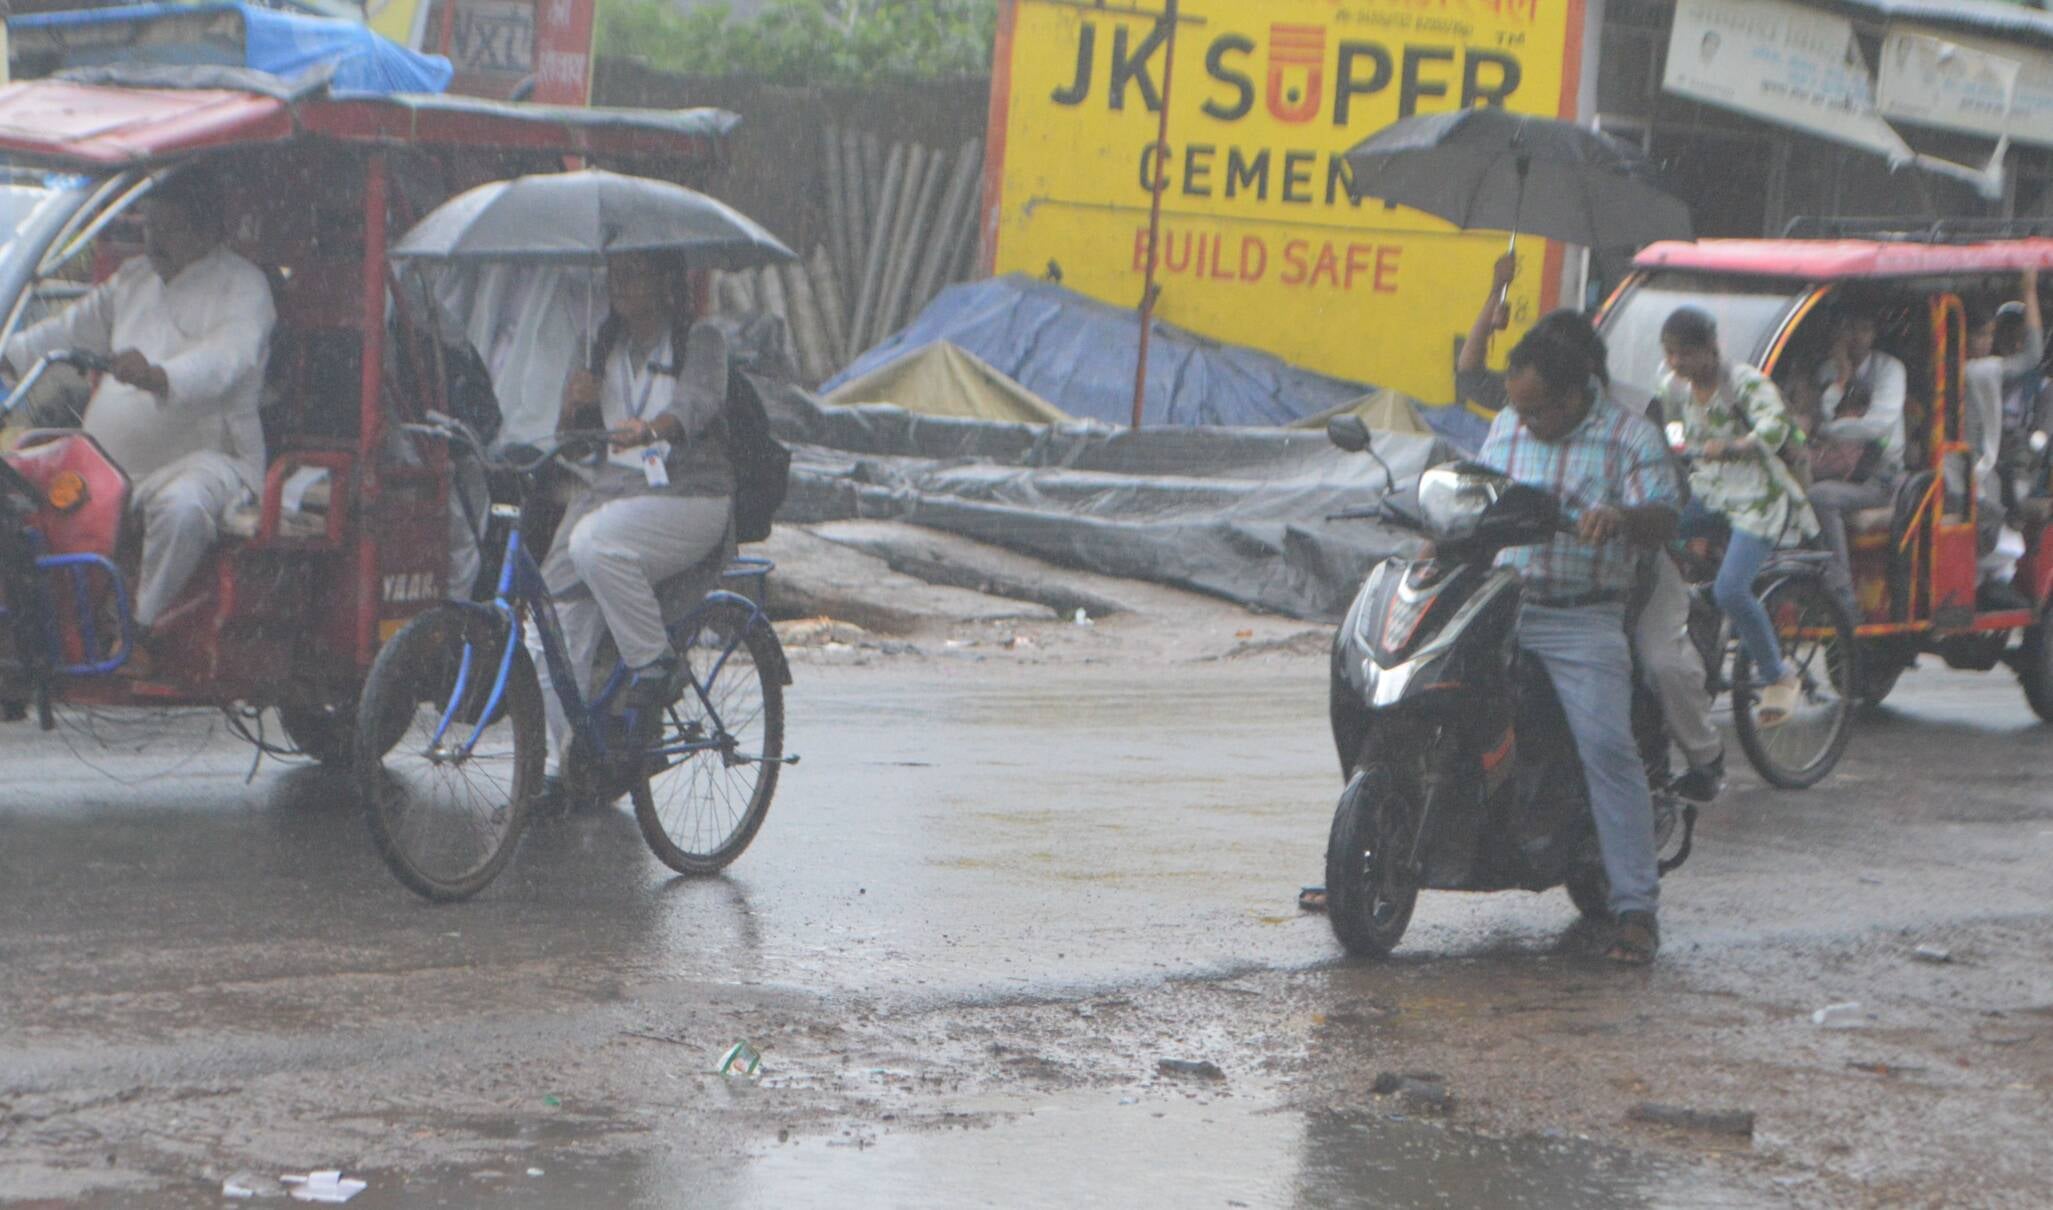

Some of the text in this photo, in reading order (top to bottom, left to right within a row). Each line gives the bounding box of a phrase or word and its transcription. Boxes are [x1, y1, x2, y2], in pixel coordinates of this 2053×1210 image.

[1050, 17, 1175, 112] JK
[1139, 143, 1398, 209] CEMEN
[1132, 226, 1403, 293] BUILD SAFE
